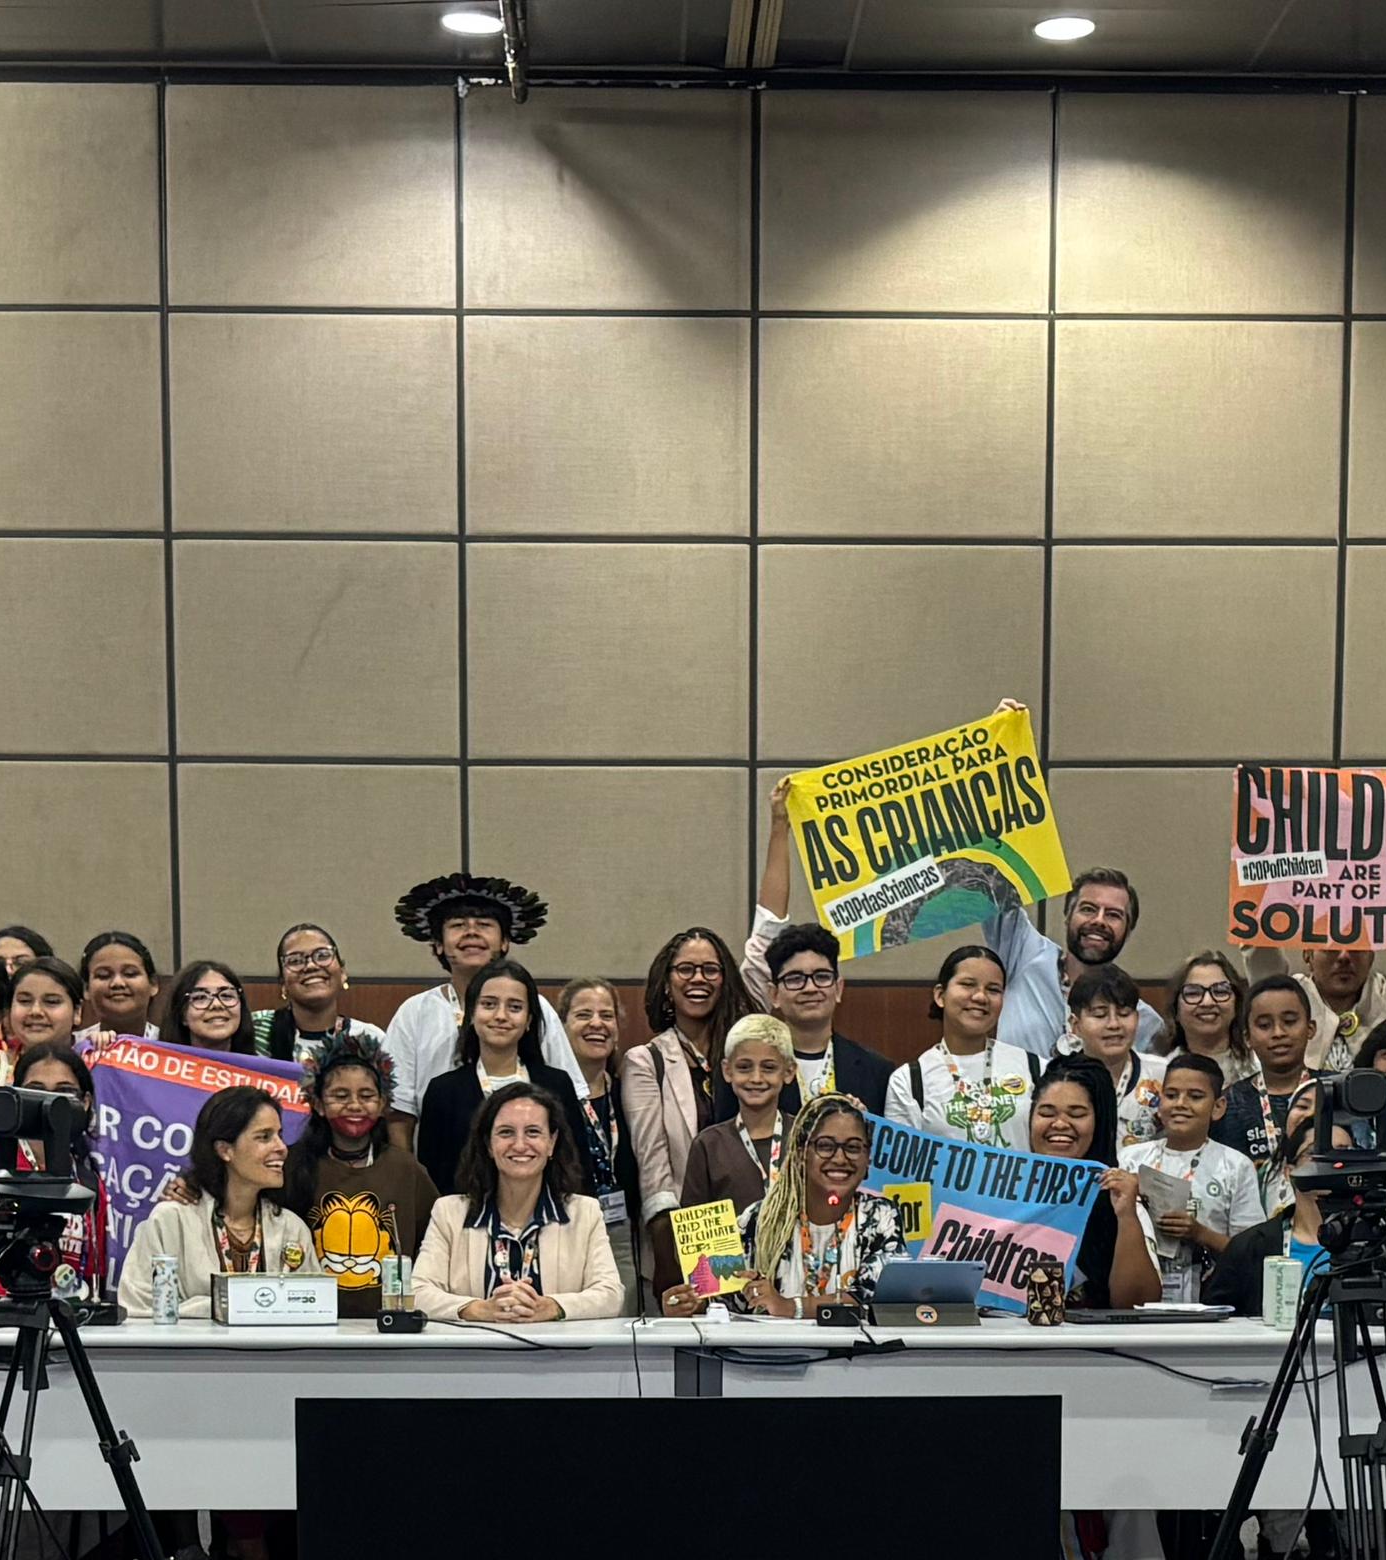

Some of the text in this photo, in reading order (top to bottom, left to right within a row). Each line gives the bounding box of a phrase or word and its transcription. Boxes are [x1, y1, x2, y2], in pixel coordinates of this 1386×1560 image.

[815, 742, 1008, 813] PRIMORDIAL PARA
[822, 728, 989, 790] CONSIDERAÇÃO
[802, 755, 1046, 890] AS CRIANÇAS
[829, 864, 941, 930] #COPdasCrianças
[1242, 856, 1324, 882] #COPofChildren
[1292, 880, 1345, 899] PART
[1351, 883, 1381, 899] OF
[1338, 864, 1381, 881] ARE
[163, 1056, 197, 1081] DE
[942, 1145, 977, 1192] TO
[977, 1152, 1027, 1202] THE
[1023, 1157, 1104, 1207] FIRST
